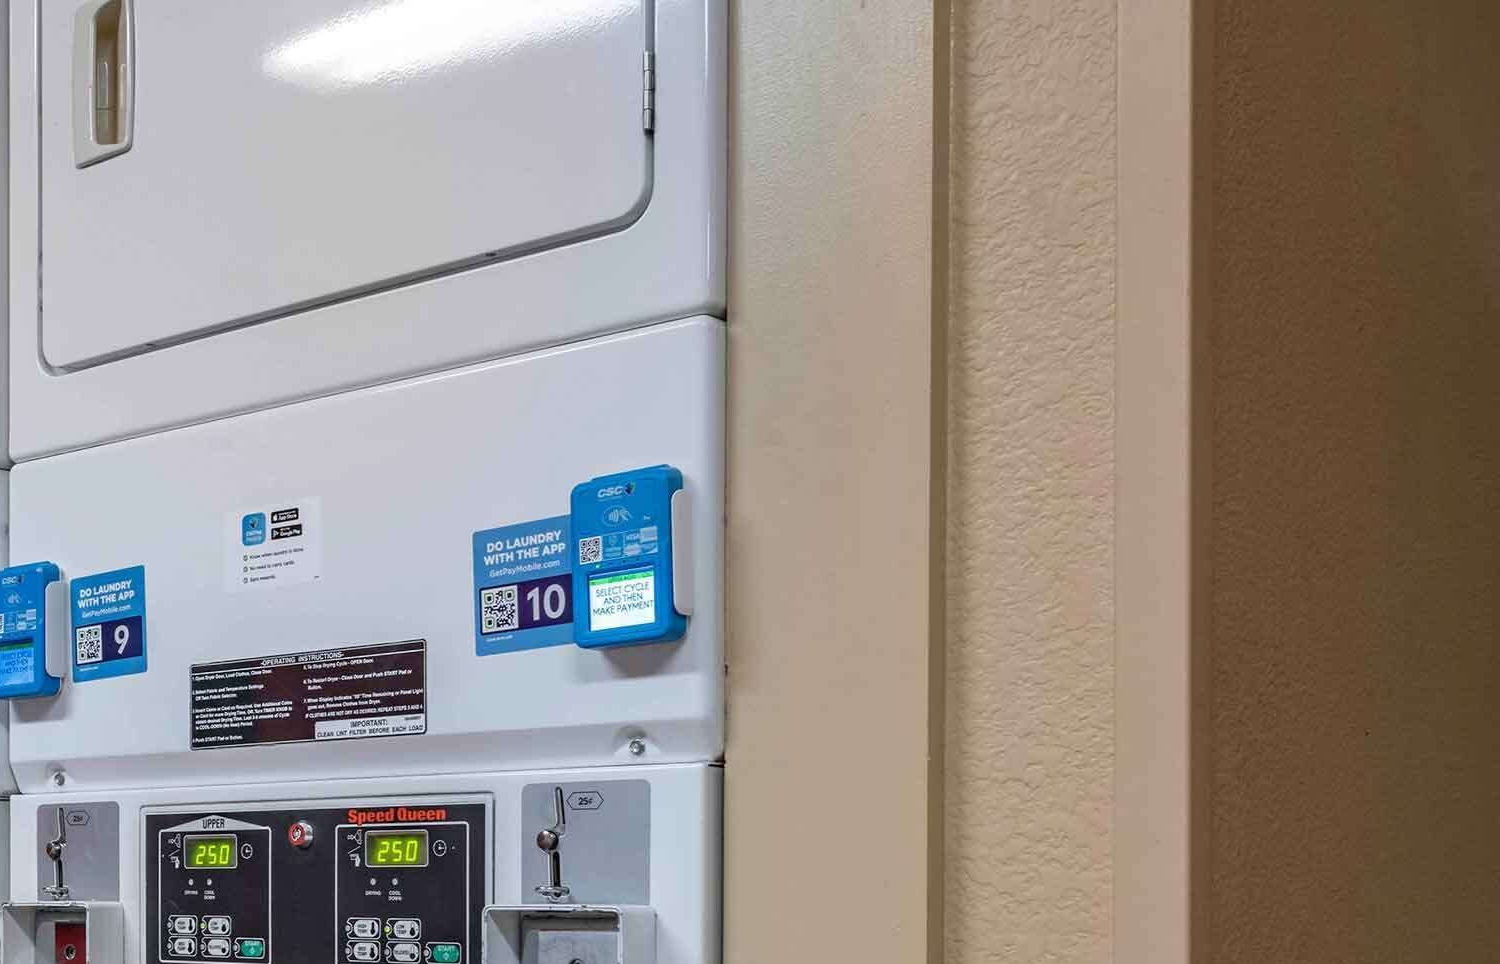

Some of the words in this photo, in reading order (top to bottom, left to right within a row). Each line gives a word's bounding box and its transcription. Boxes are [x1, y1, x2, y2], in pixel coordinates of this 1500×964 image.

[598, 487, 622, 498] CSC
[486, 541, 504, 553] DO
[507, 531, 562, 549] LAUNDRY
[484, 554, 514, 566] WITH
[516, 547, 540, 561] THE
[543, 543, 566, 555] APP
[80, 589, 91, 598] DO
[94, 580, 132, 595] LAUNDRY
[596, 586, 622, 598] SELECT
[624, 582, 650, 592] CYCLE
[604, 595, 622, 604] AND
[623, 592, 643, 602] THEN
[78, 597, 99, 609] WITH
[101, 594, 116, 604] THE
[118, 590, 135, 601] APP
[527, 583, 566, 621] 10
[592, 605, 616, 616] MAKE
[617, 601, 653, 613] PAYMENT
[114, 625, 129, 655] 9
[350, 719, 388, 728] IMPORTANT:
[202, 819, 225, 829] UPPER
[348, 808, 394, 825] Speed
[397, 808, 446, 821] Queen
[195, 845, 230, 865] 250
[377, 840, 418, 863] 250
